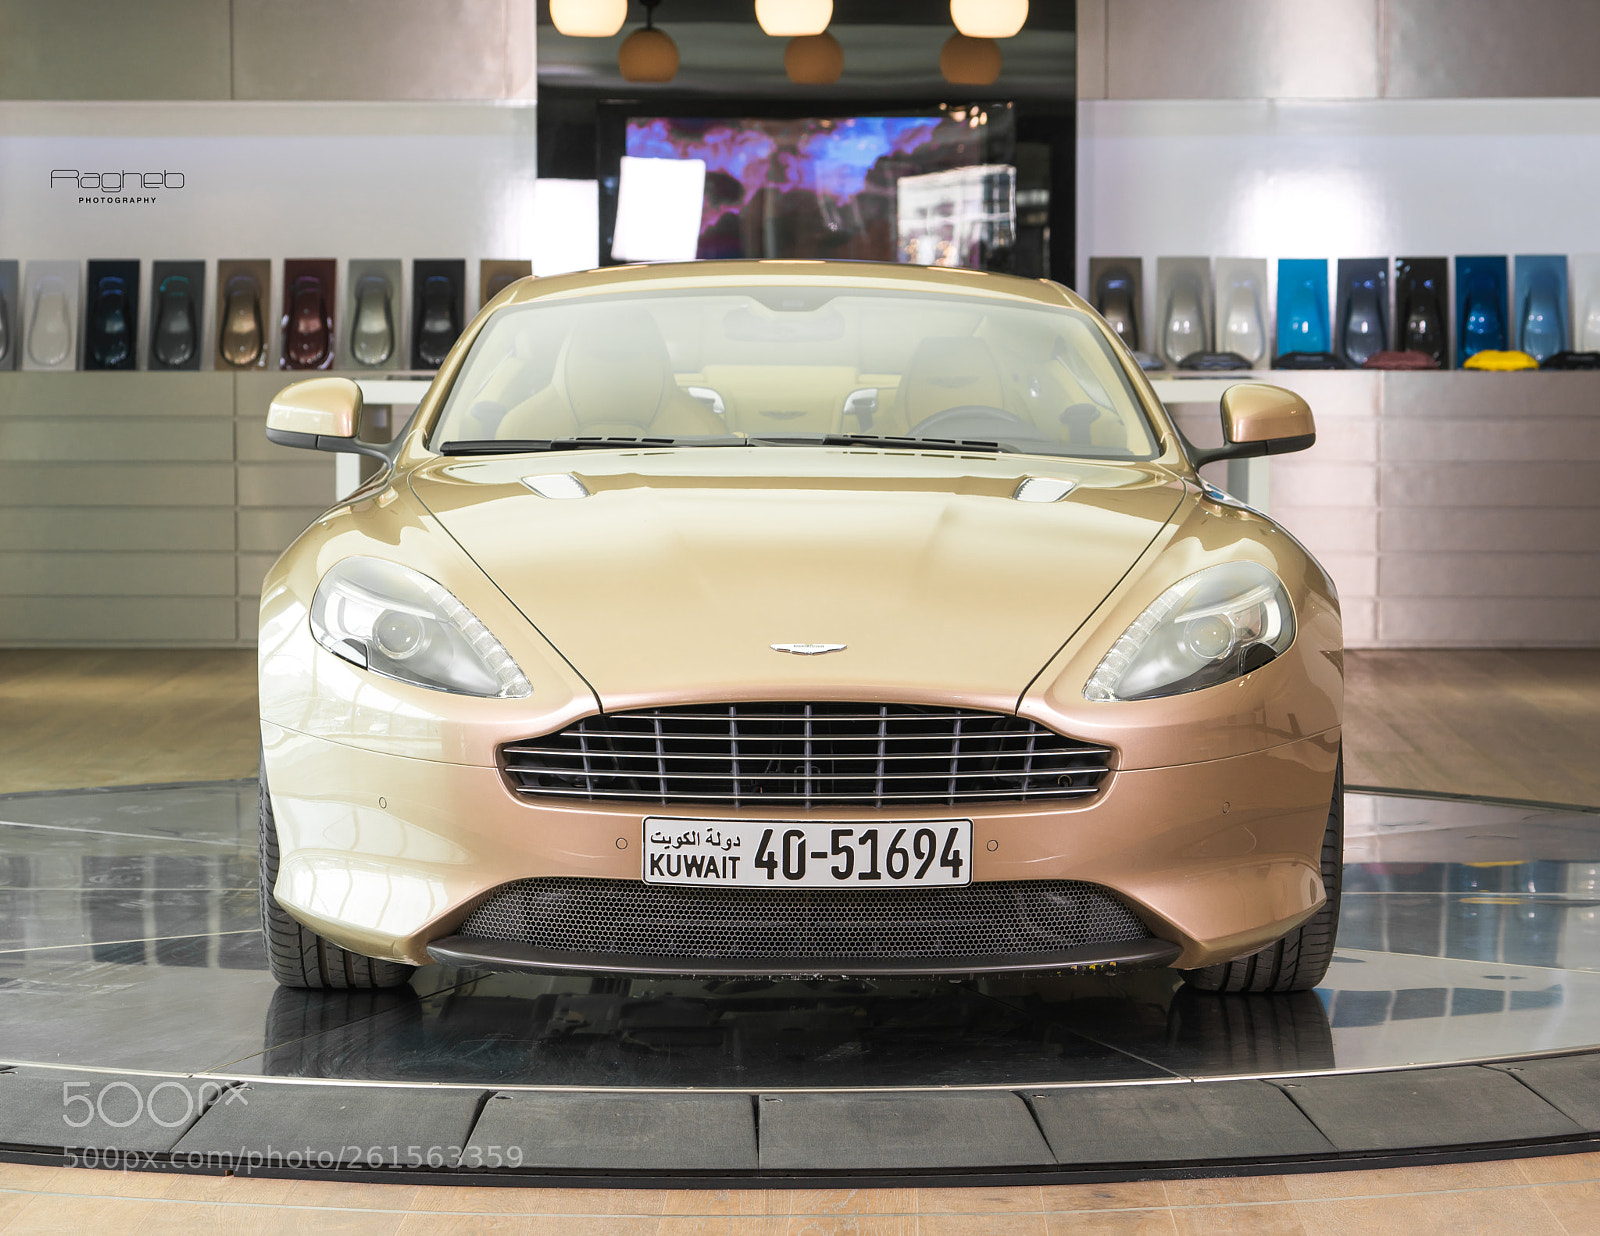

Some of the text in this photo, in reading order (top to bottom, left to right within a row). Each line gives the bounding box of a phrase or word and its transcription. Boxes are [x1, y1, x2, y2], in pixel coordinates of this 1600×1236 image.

[650, 828, 741, 851] دولة الكويت
[650, 853, 741, 879] KUWAIT
[754, 827, 964, 881] 40-51694
